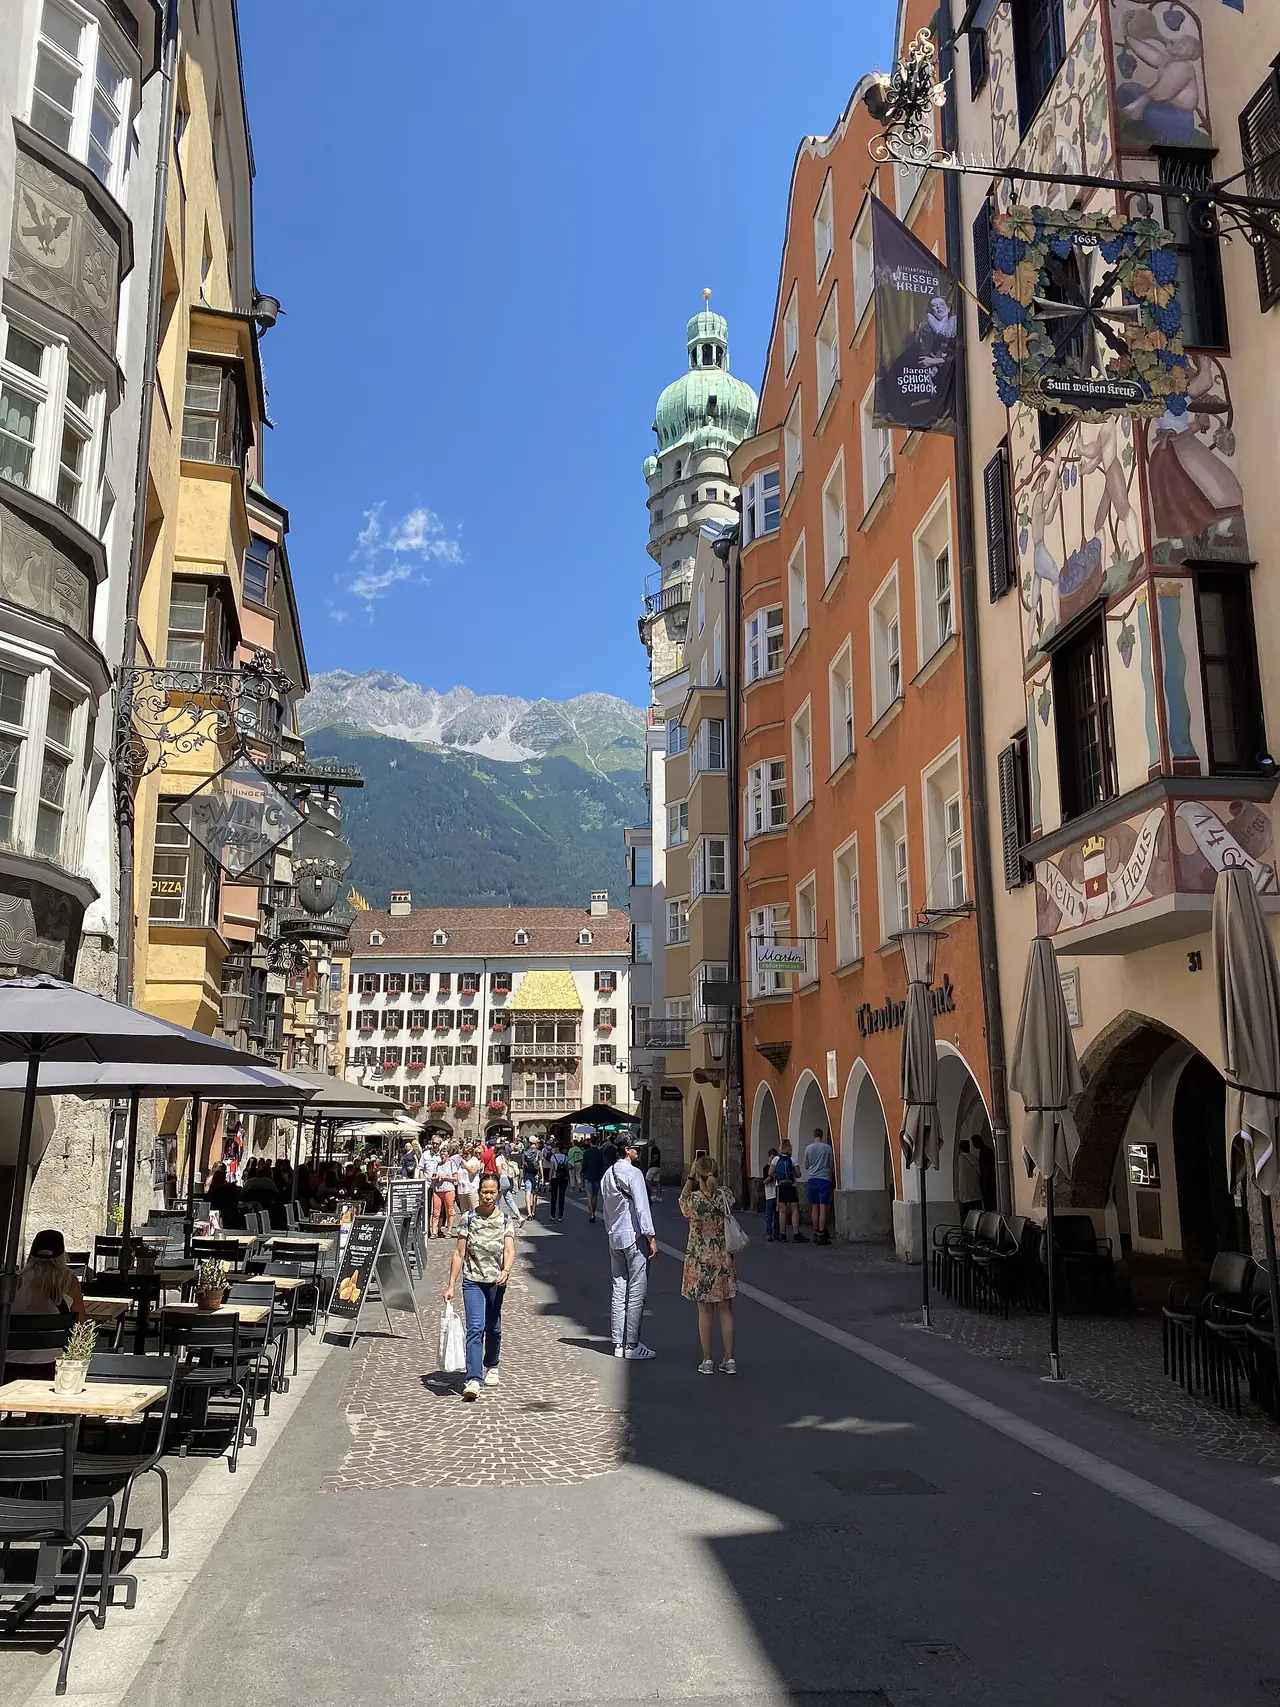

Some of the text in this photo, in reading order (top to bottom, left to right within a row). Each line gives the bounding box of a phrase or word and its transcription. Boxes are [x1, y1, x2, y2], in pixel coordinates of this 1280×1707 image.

[1073, 234, 1097, 245] 1665
[892, 271, 939, 286] WEISSES
[896, 281, 935, 295] KREUZ
[897, 374, 930, 386] SCHICK
[901, 383, 938, 394] SCHOCK
[1046, 378, 1137, 398] Zum weißen Kreuz
[1121, 827, 1152, 901] Haus
[151, 880, 182, 893] PIZZA
[758, 949, 804, 962] Martin
[1187, 951, 1203, 972] 31
